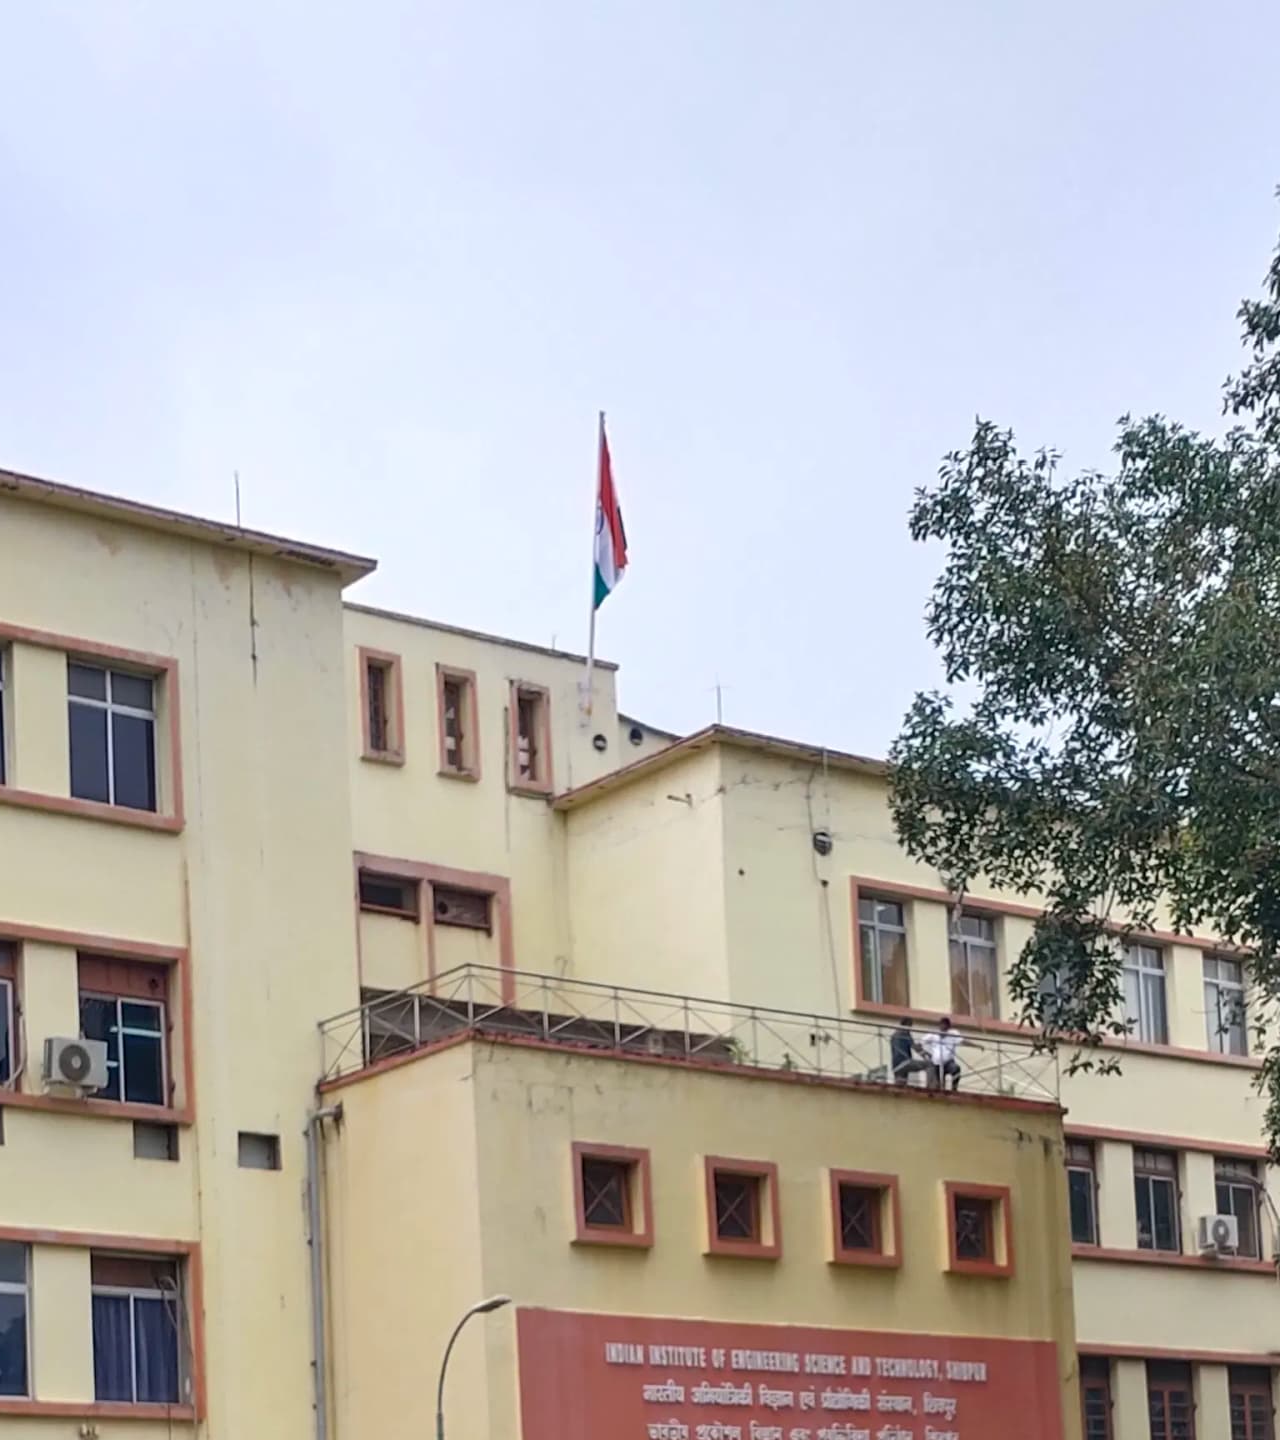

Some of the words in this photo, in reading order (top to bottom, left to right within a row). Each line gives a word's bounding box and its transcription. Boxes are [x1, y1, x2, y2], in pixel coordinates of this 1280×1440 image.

[605, 1342, 644, 1365] INDIAN
[648, 1345, 707, 1368] INSTITUTE
[712, 1348, 726, 1368] OF
[731, 1350, 799, 1373] ENGINEERING
[805, 1353, 847, 1375] SCIENCE
[851, 1356, 871, 1376] AND
